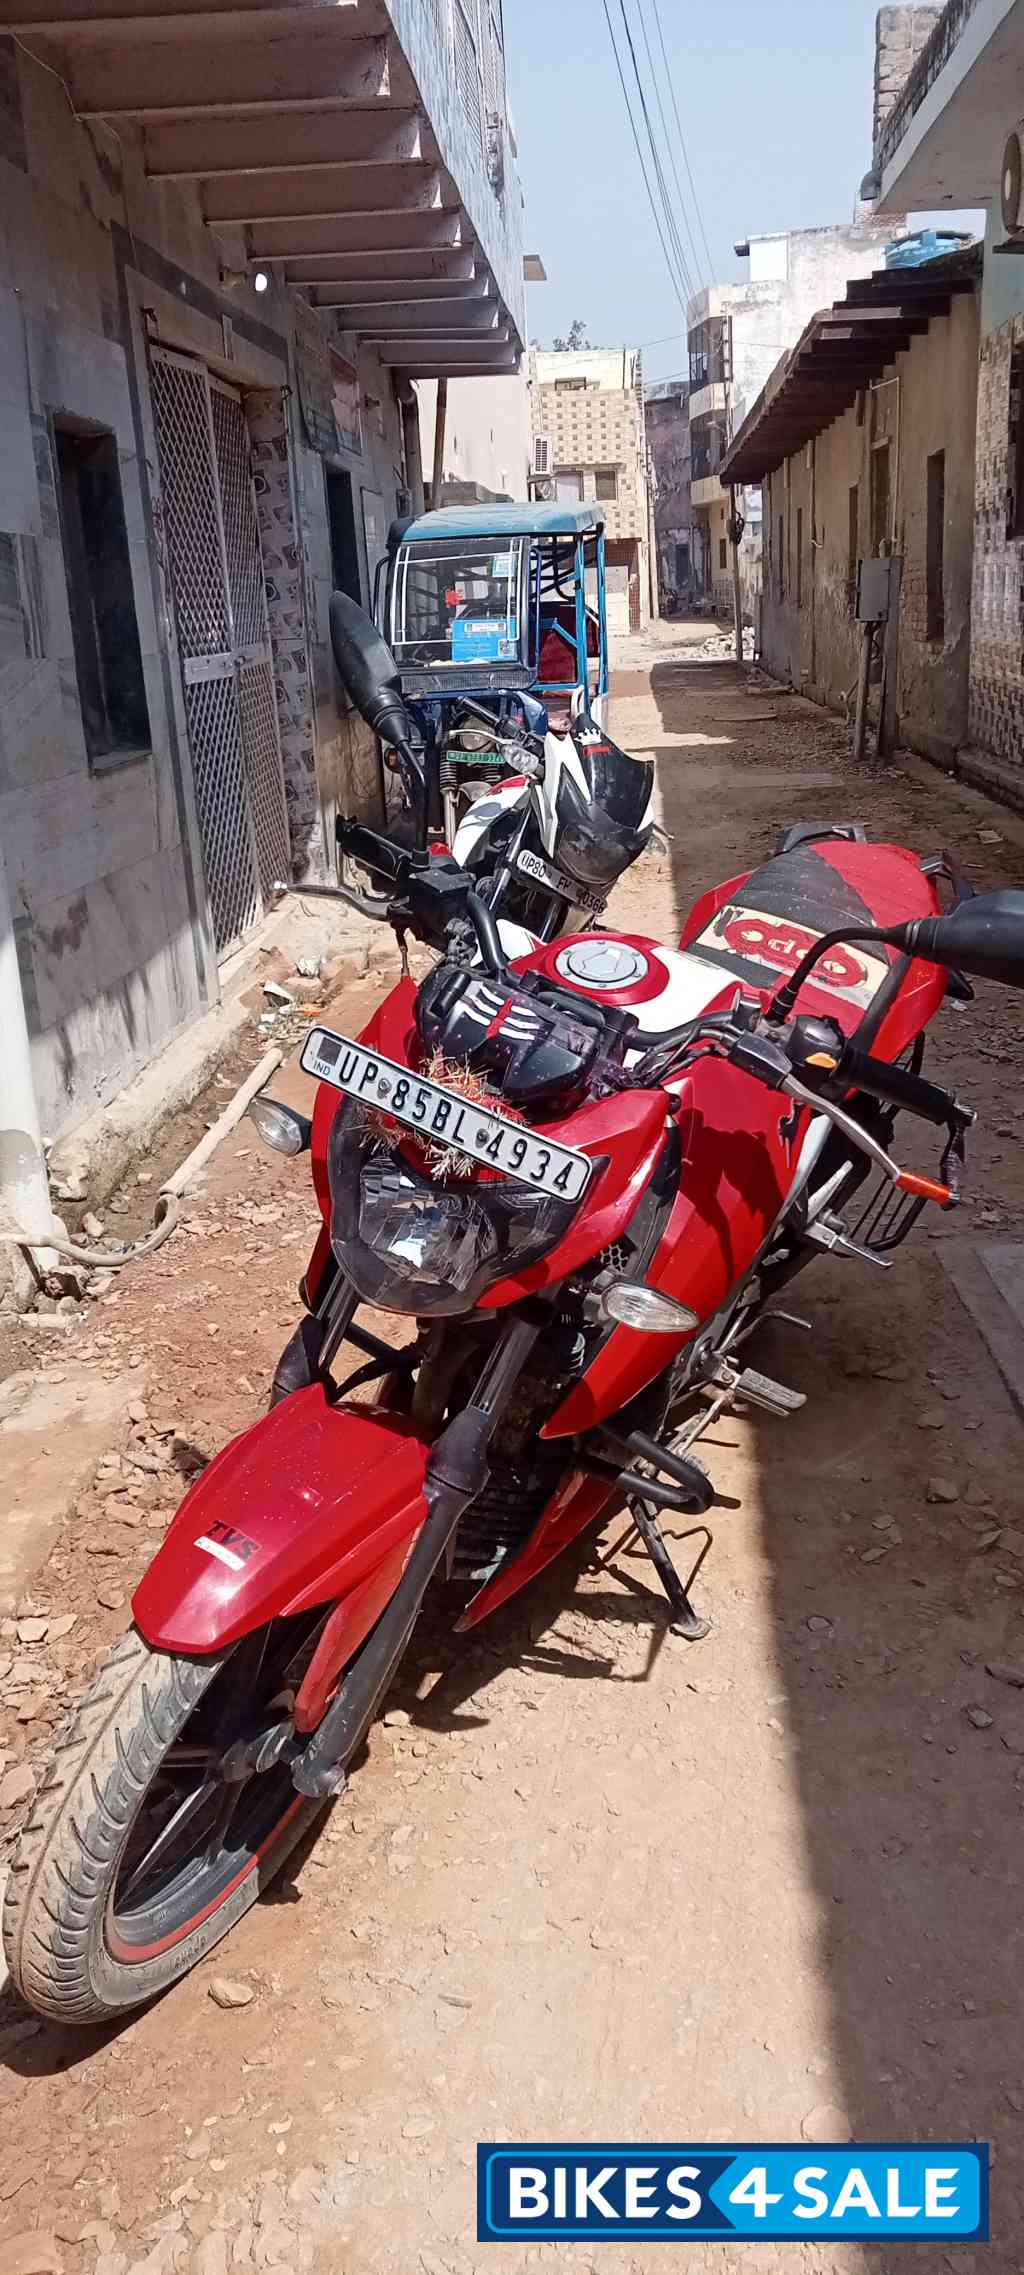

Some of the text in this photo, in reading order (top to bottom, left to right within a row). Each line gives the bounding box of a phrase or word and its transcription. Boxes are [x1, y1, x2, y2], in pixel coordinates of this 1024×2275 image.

[313, 1060, 331, 1076] IND
[339, 1050, 379, 1093] UP
[485, 1129, 576, 1192] 4934
[205, 1519, 260, 1560] TVS
